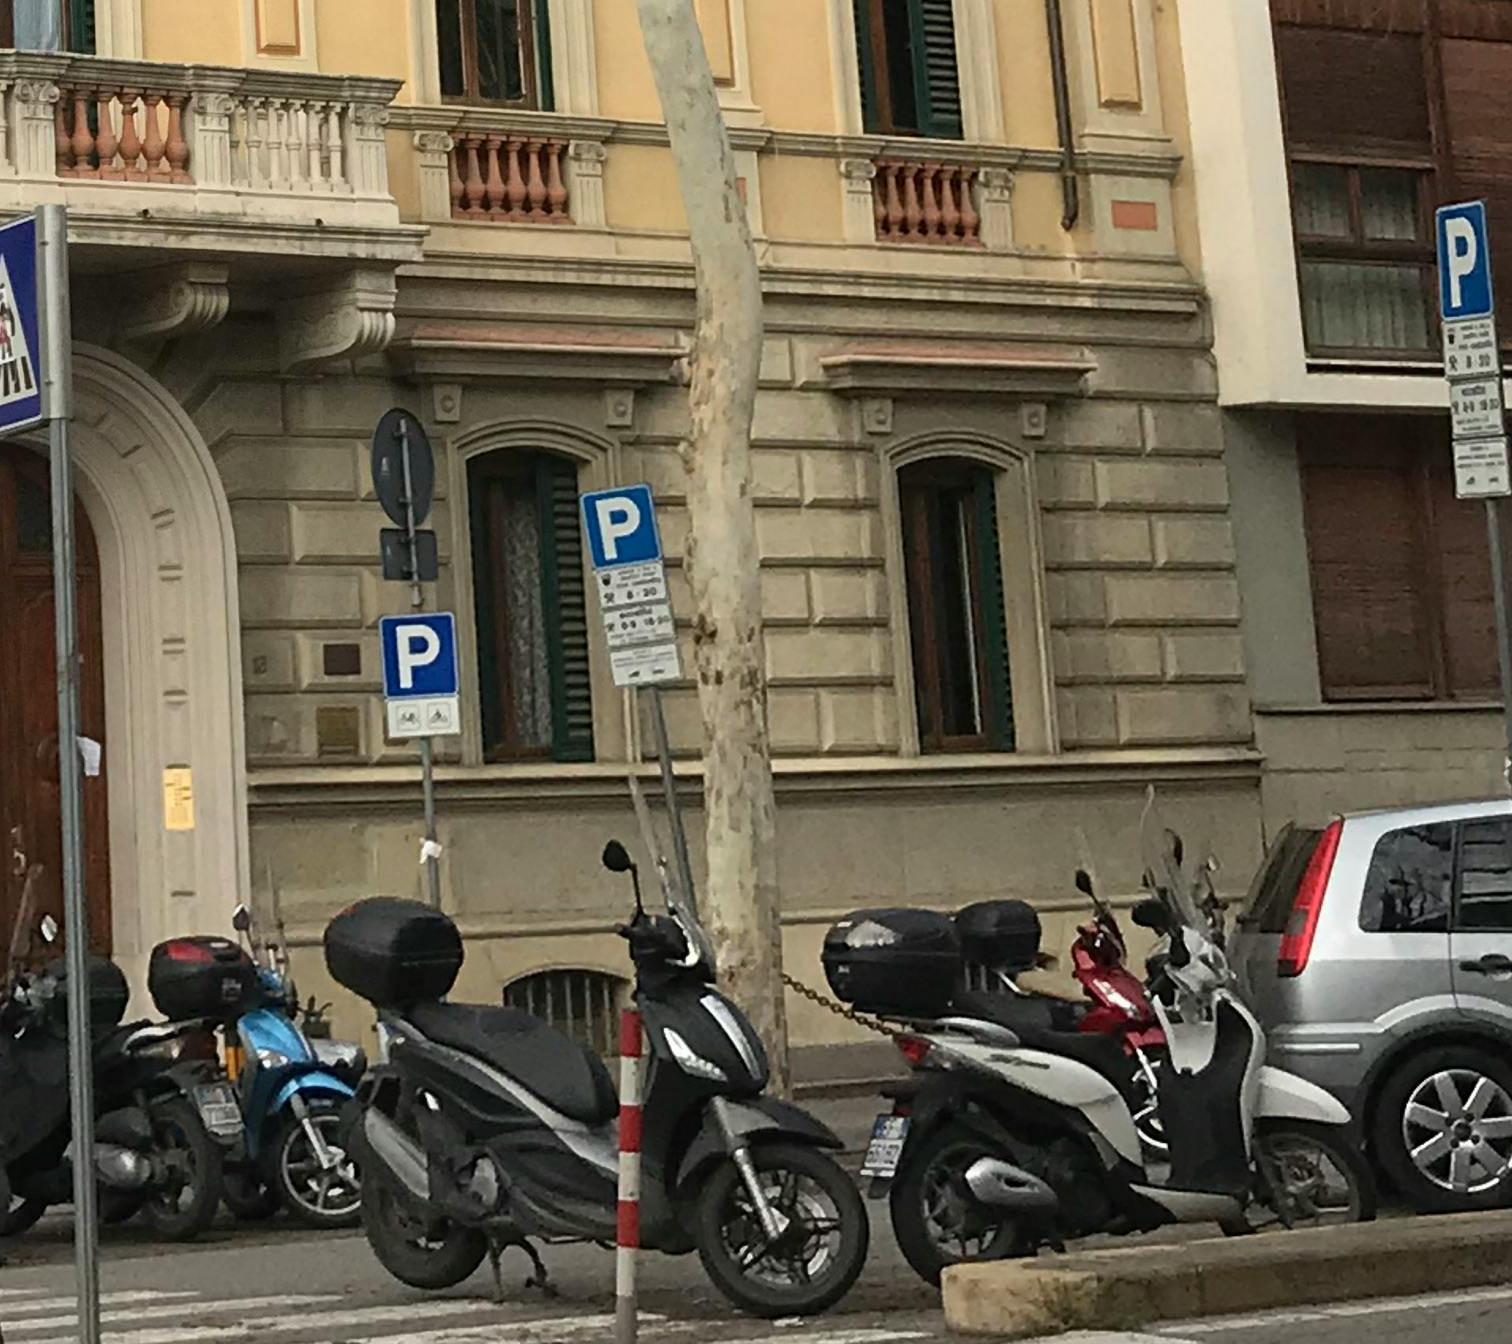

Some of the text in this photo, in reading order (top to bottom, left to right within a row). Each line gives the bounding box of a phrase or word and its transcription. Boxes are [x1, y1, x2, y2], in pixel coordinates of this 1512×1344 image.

[1445, 217, 1477, 309] P
[595, 496, 641, 561] P
[395, 624, 441, 689] P
